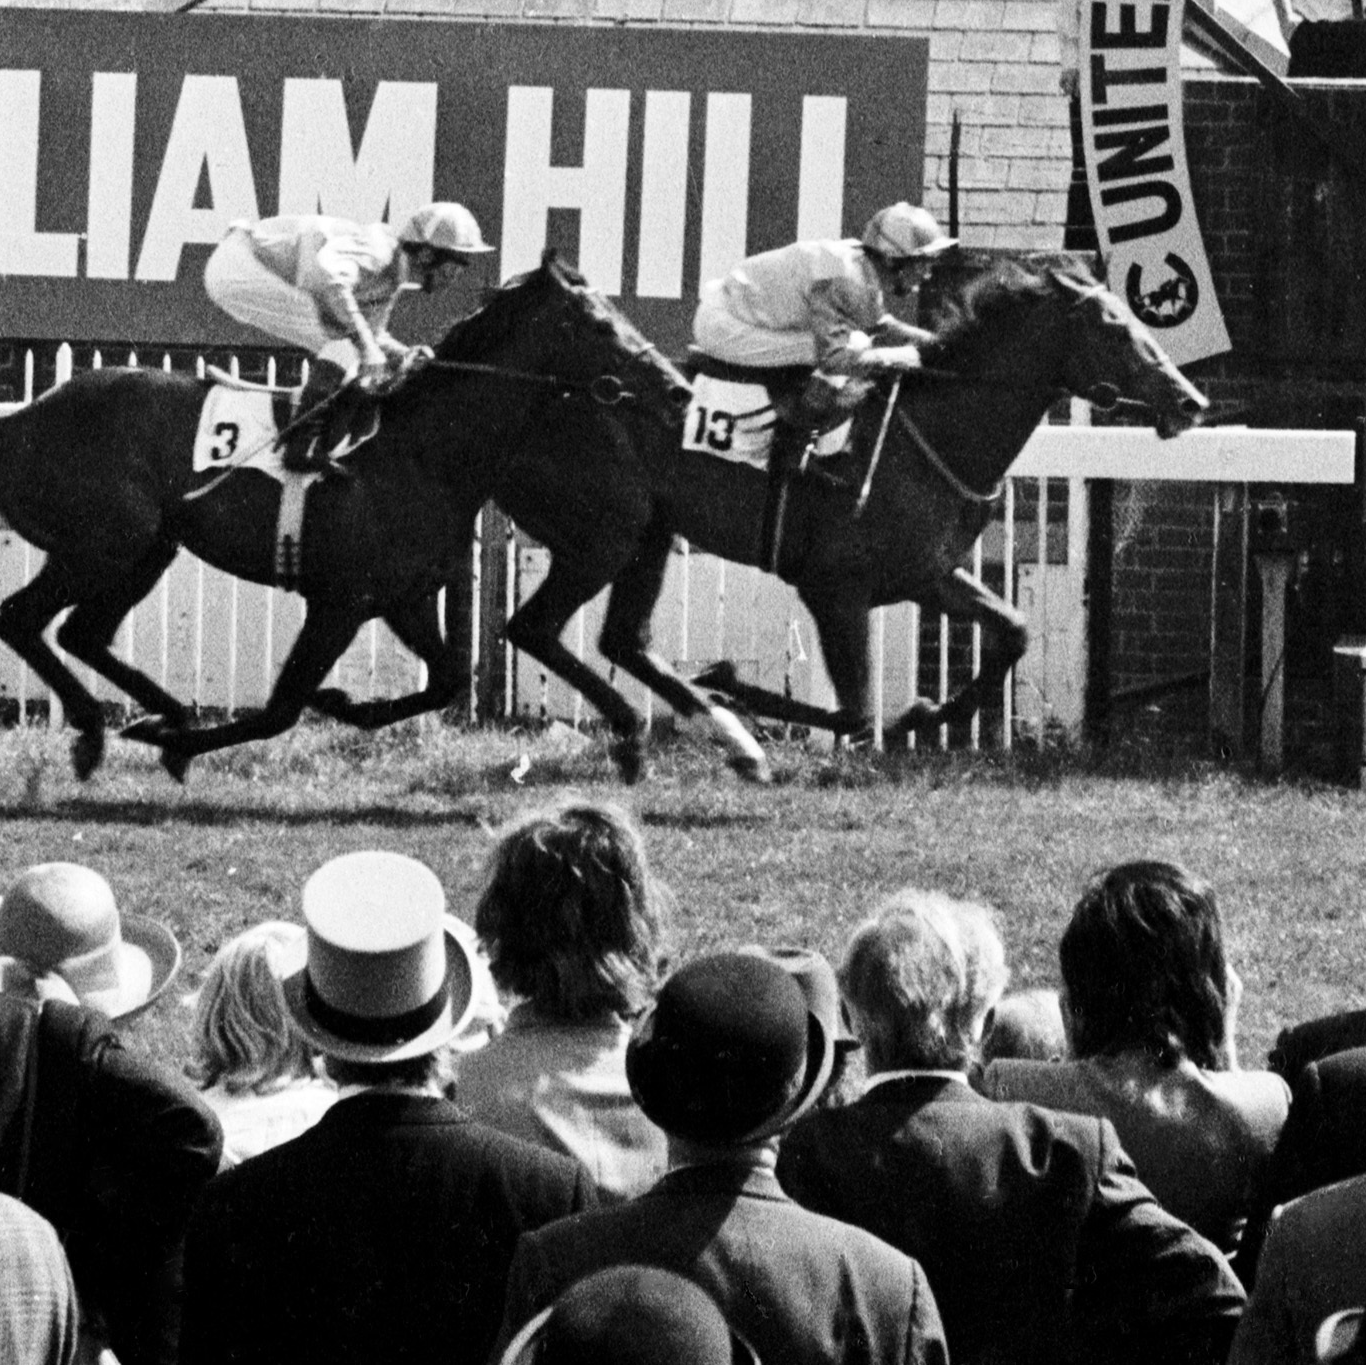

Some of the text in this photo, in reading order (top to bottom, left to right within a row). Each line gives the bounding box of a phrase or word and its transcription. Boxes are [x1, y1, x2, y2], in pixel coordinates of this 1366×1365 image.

[499, 84, 848, 299] HILL
[210, 421, 240, 461] 3
[693, 405, 736, 452] 13
